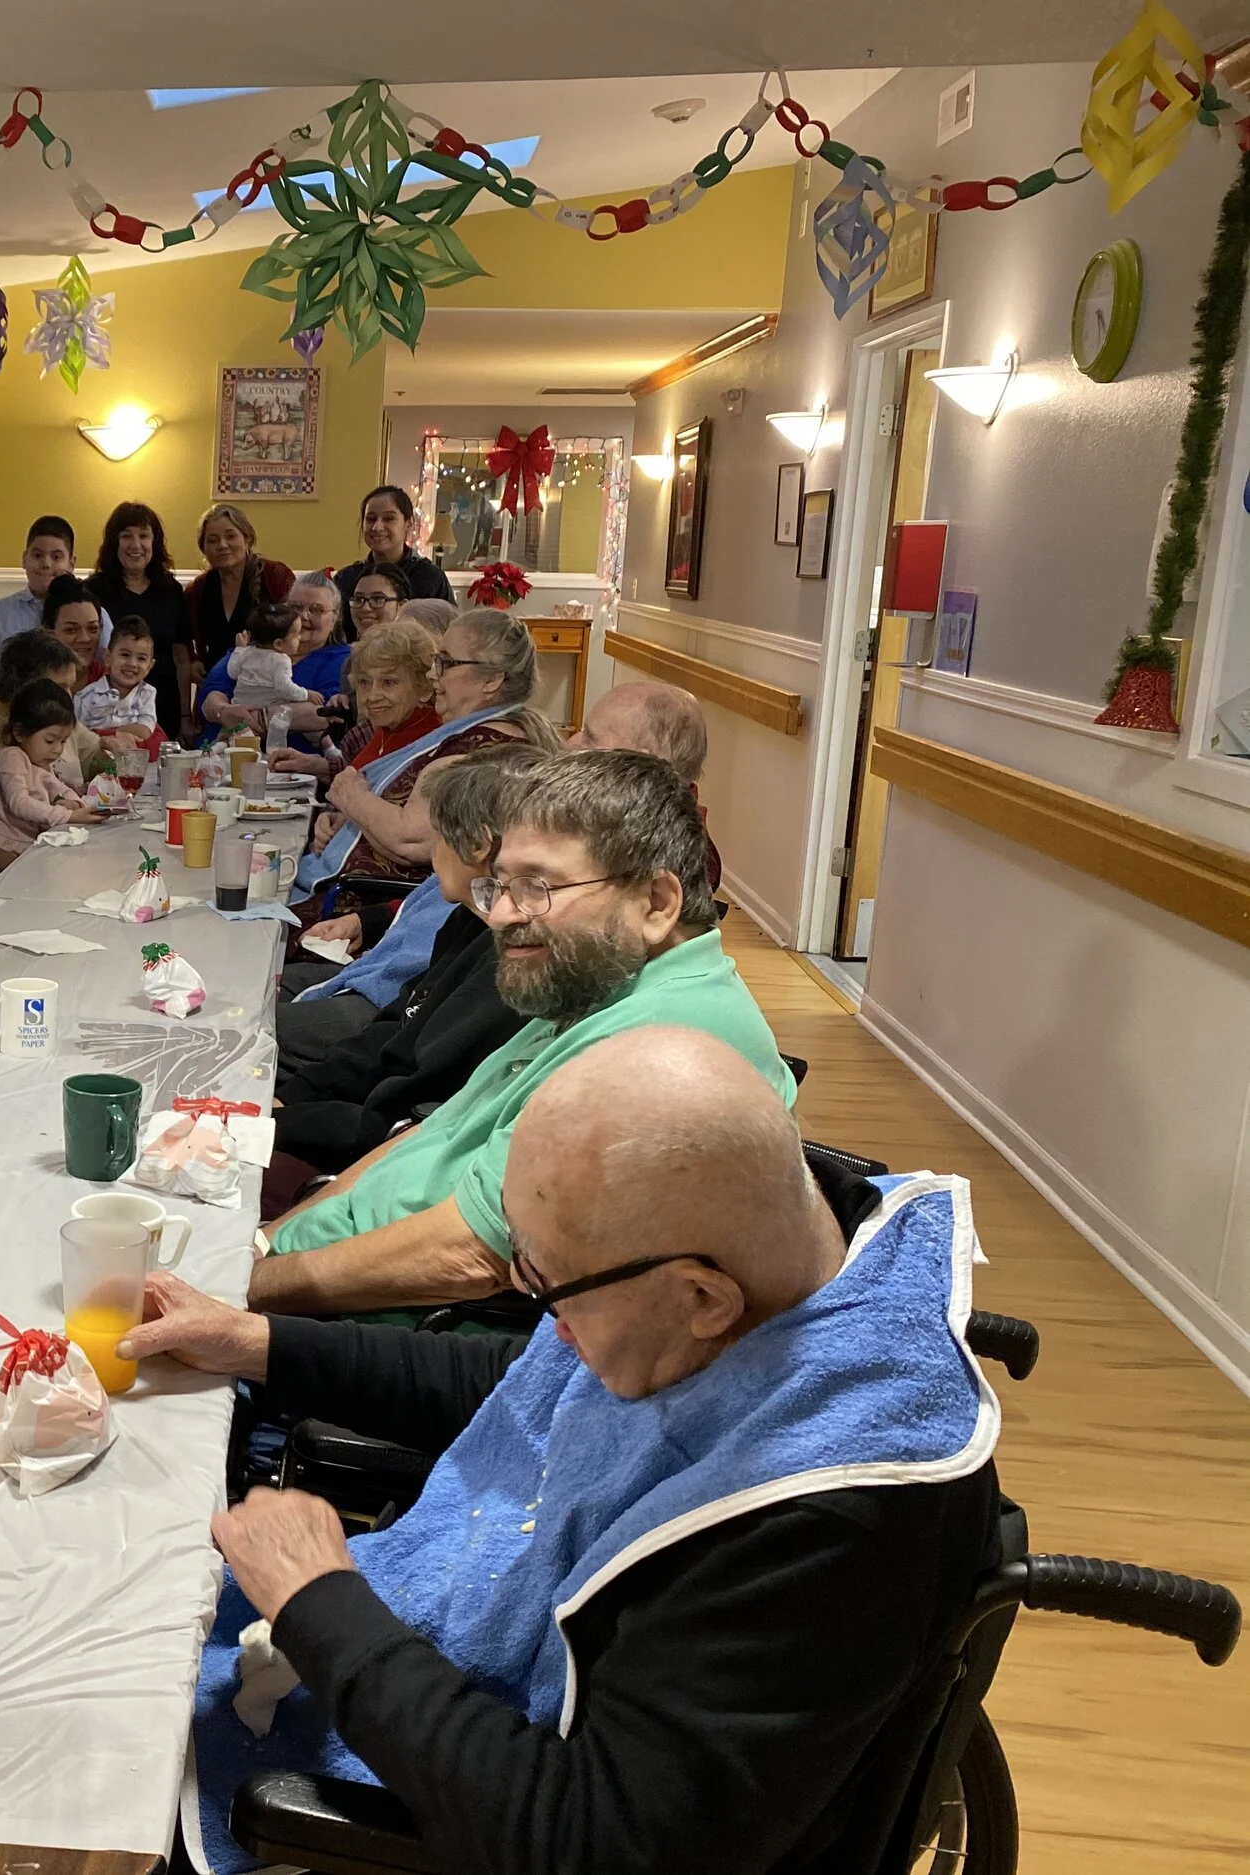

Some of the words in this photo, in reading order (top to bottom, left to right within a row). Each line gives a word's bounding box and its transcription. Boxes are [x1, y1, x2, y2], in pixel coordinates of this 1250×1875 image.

[249, 386, 290, 395] COUNTRY
[18, 1026, 49, 1035] SPICERS
[21, 1040, 45, 1048] PAPER
